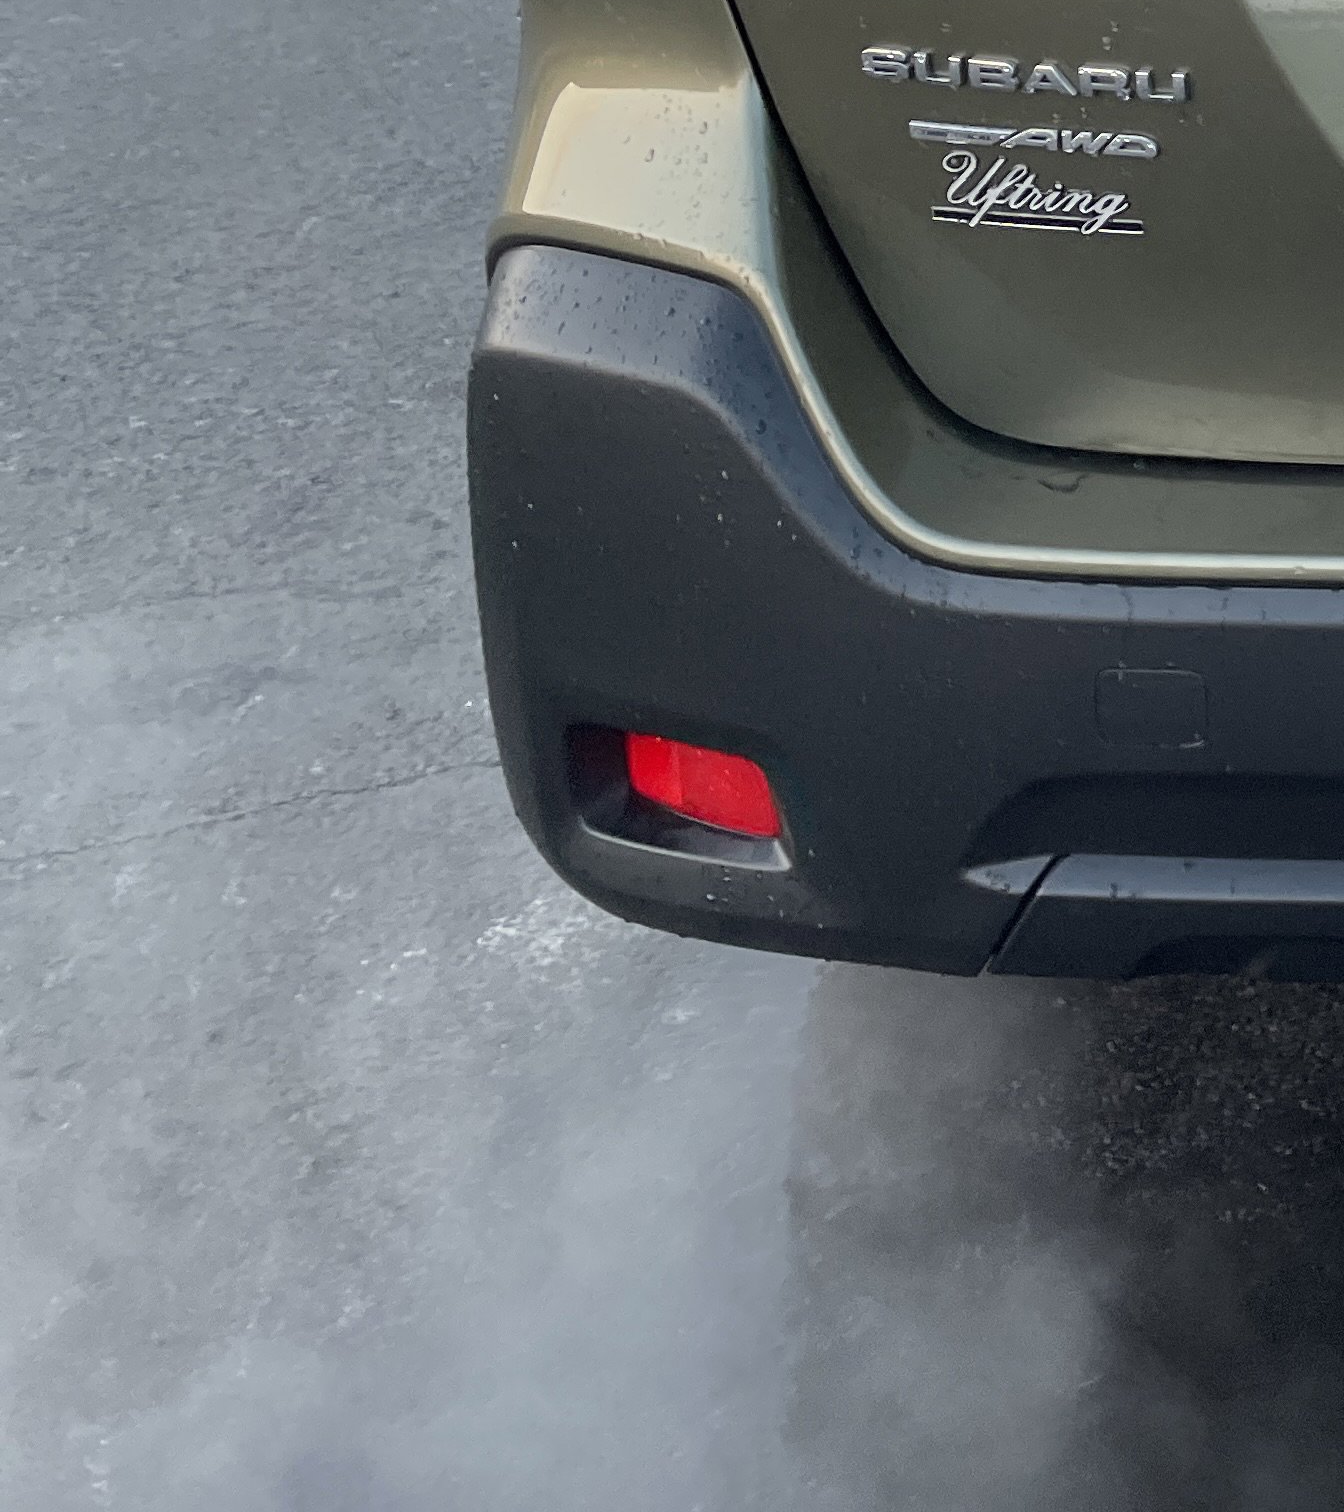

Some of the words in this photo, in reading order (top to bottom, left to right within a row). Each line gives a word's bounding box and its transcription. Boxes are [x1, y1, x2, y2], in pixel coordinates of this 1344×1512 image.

[861, 45, 1191, 103] SUBARU
[1000, 127, 1158, 159] AWD
[942, 149, 1130, 234] Uftring
